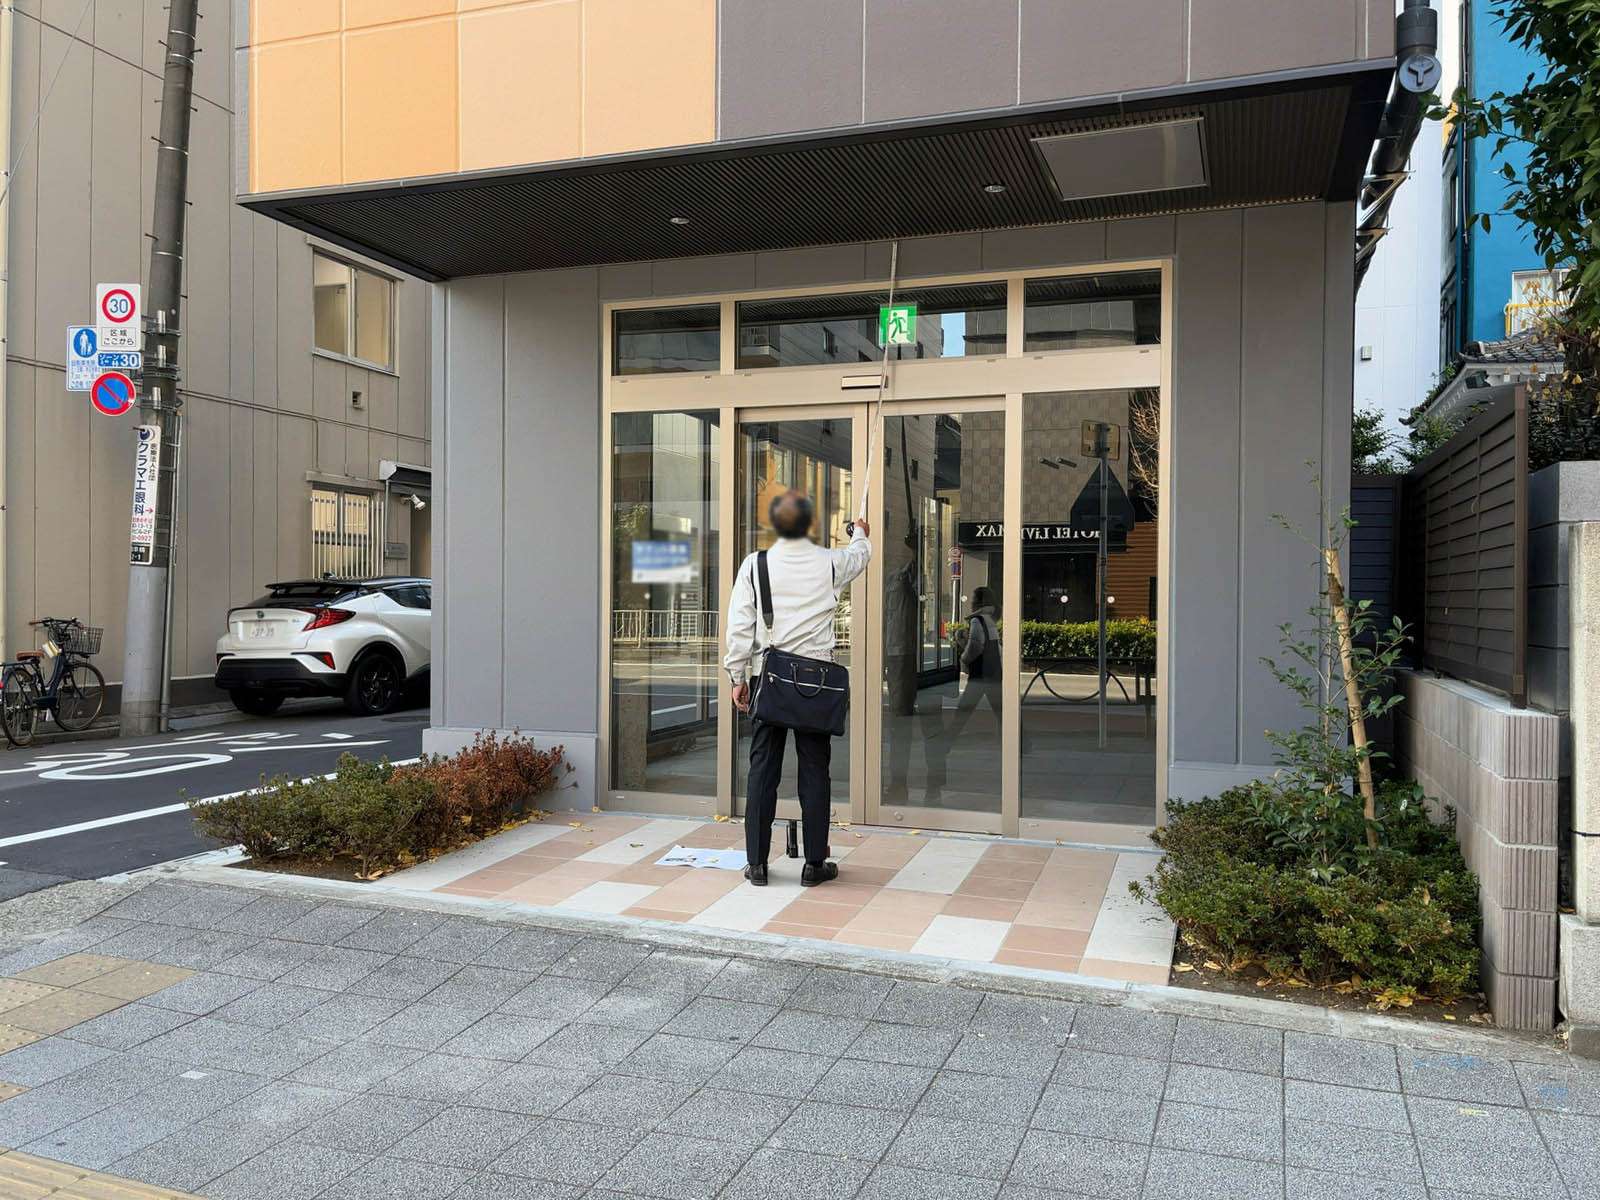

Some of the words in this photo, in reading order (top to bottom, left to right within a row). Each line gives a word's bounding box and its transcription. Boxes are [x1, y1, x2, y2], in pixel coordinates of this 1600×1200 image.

[109, 298, 129, 314] 30
[103, 337, 134, 346] ここから
[134, 440, 149, 516] クラマエ眼科
